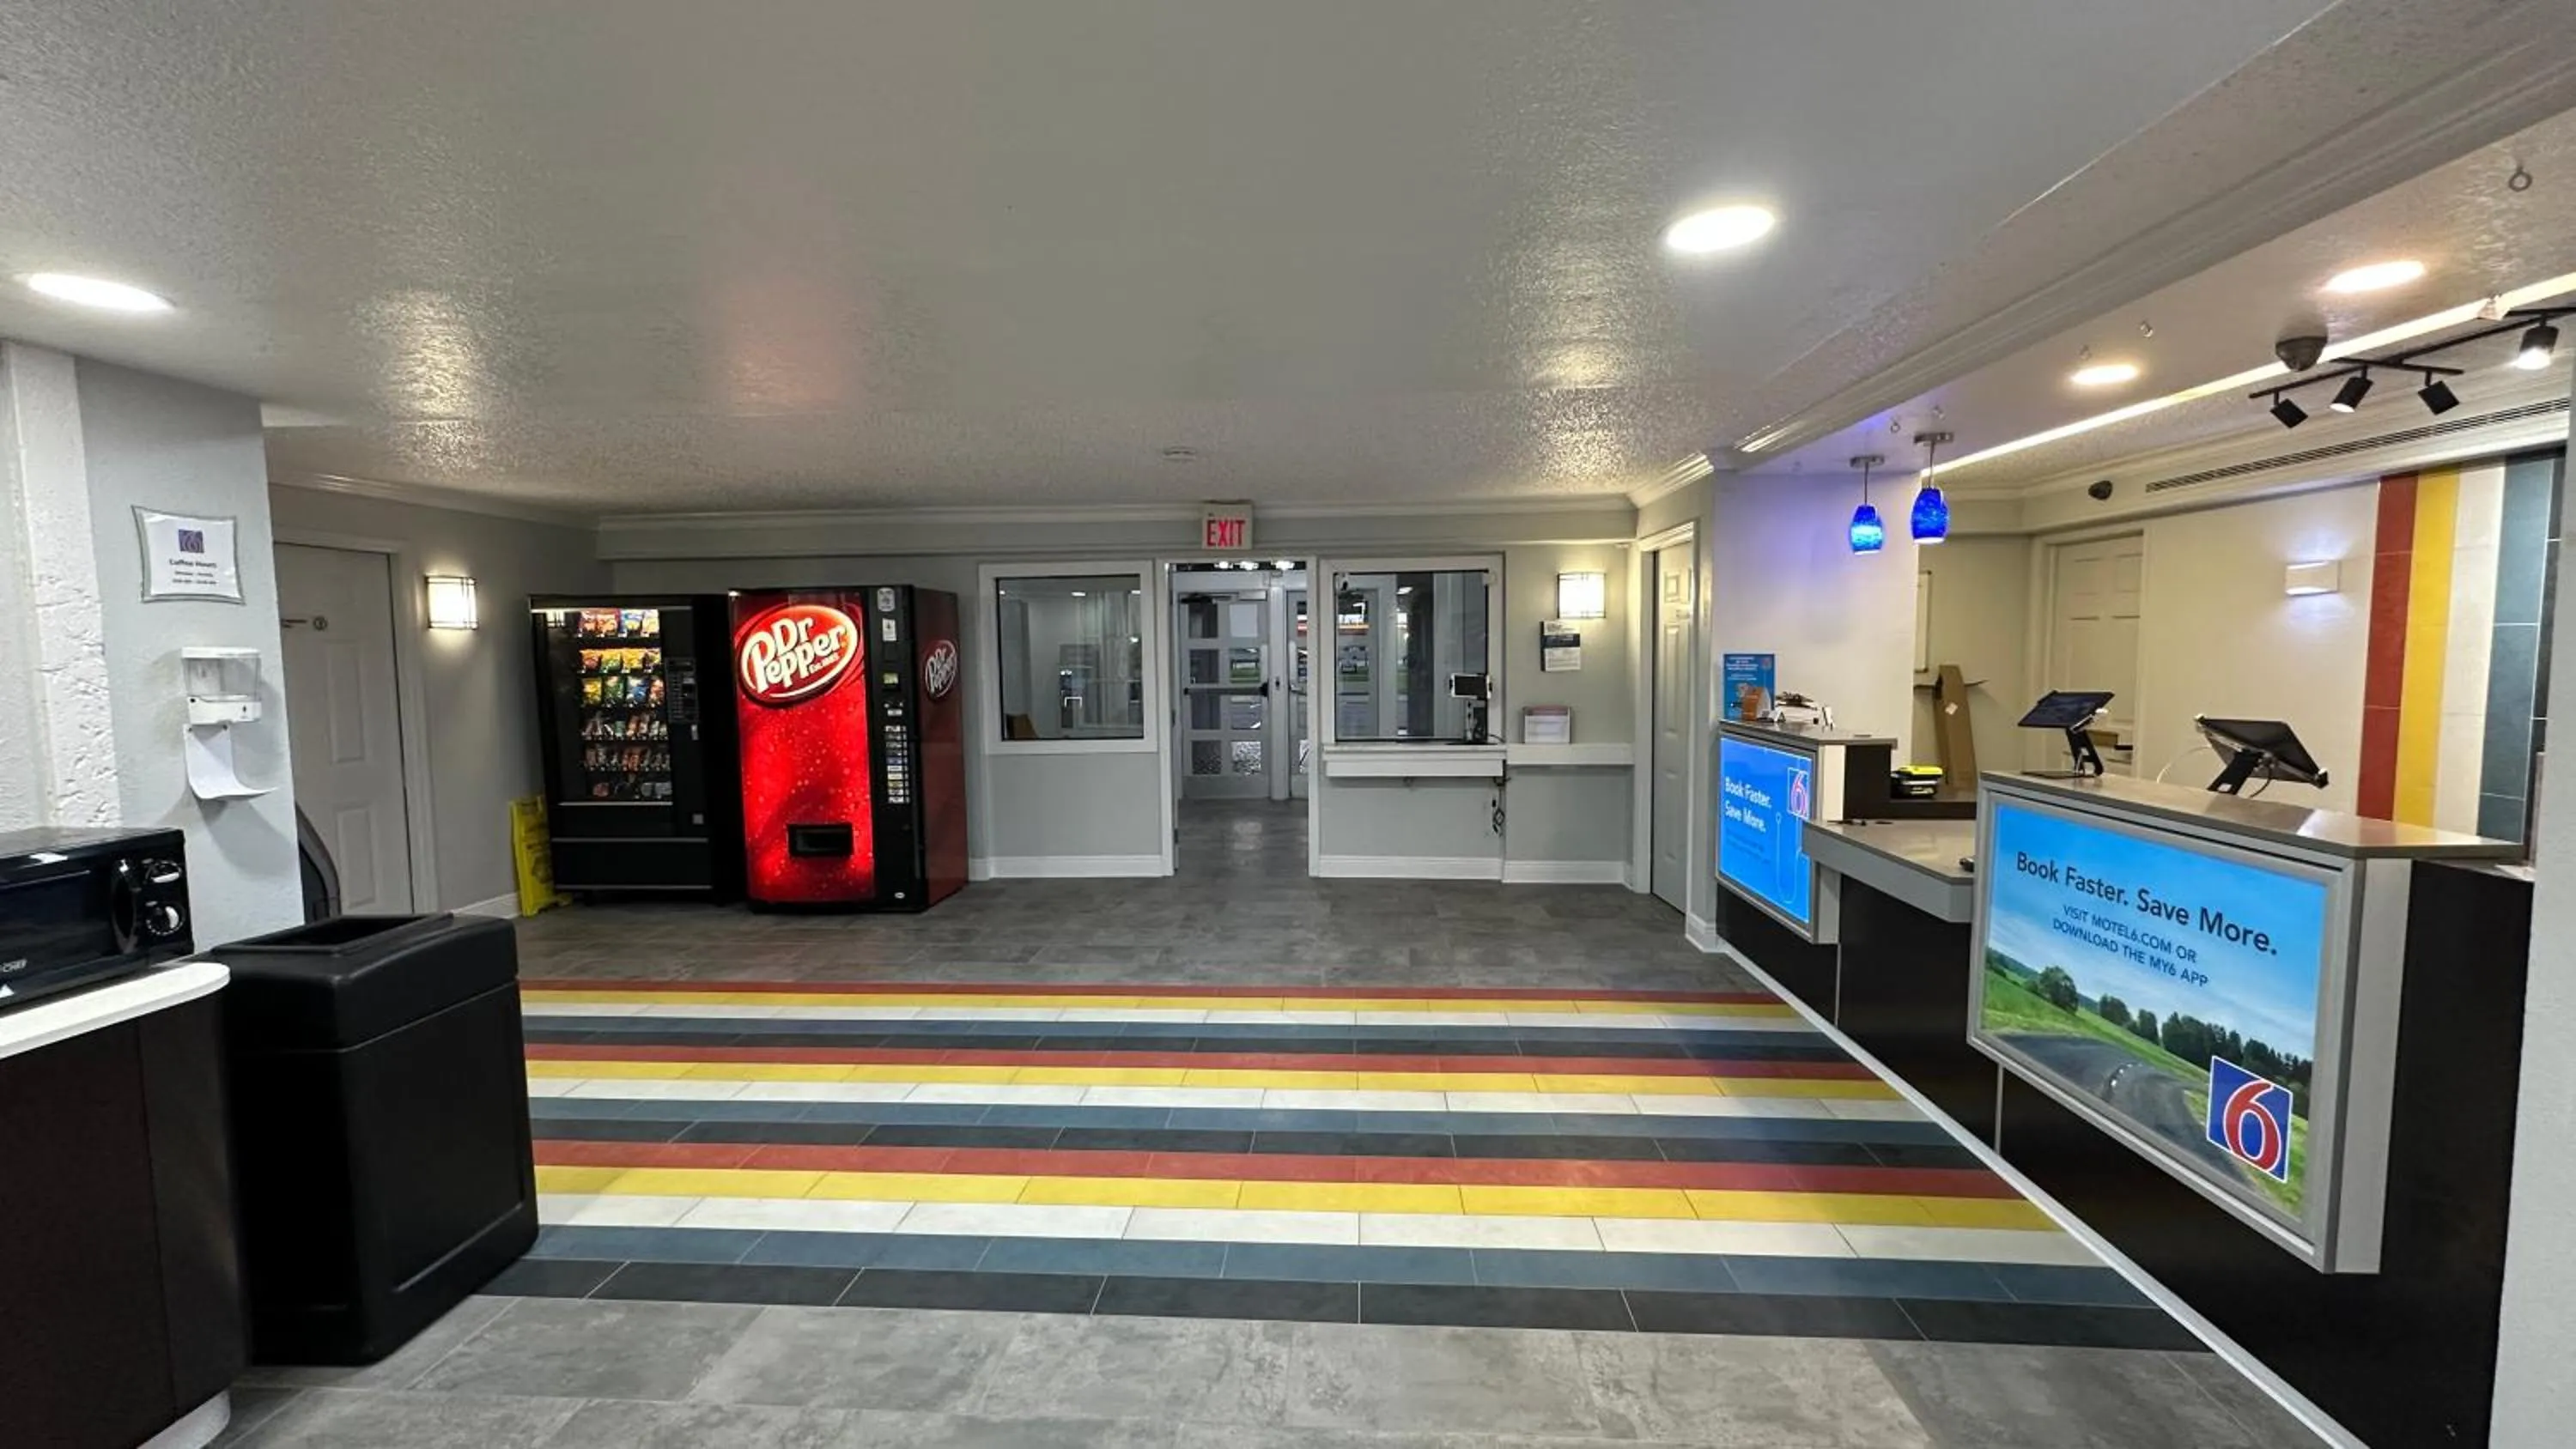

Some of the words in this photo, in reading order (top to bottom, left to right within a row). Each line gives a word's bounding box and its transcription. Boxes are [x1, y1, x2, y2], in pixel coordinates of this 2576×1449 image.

[1206, 519, 1246, 547] EXIT
[741, 625, 847, 694] Pepper
[771, 617, 814, 657] Dr
[1725, 776, 1744, 797] Book
[1745, 784, 1771, 809] Faster.
[1725, 800, 1742, 822] Save
[1742, 807, 1766, 833] More.
[1790, 771, 1807, 817] 6
[2016, 851, 2059, 883] Book
[2065, 866, 2129, 906] Faster.
[2136, 888, 2190, 926] Save
[2199, 906, 2277, 955] More.
[2053, 918, 2119, 953] DOWNLOAD
[2122, 944, 2146, 964] THE
[2149, 955, 2178, 977] MY6
[2180, 967, 2209, 987] APP
[2063, 904, 2089, 923] VISIT
[2092, 914, 2172, 955] MOTEL6.COM
[2175, 945, 2197, 964] OR
[2223, 1079, 2281, 1173] 6
